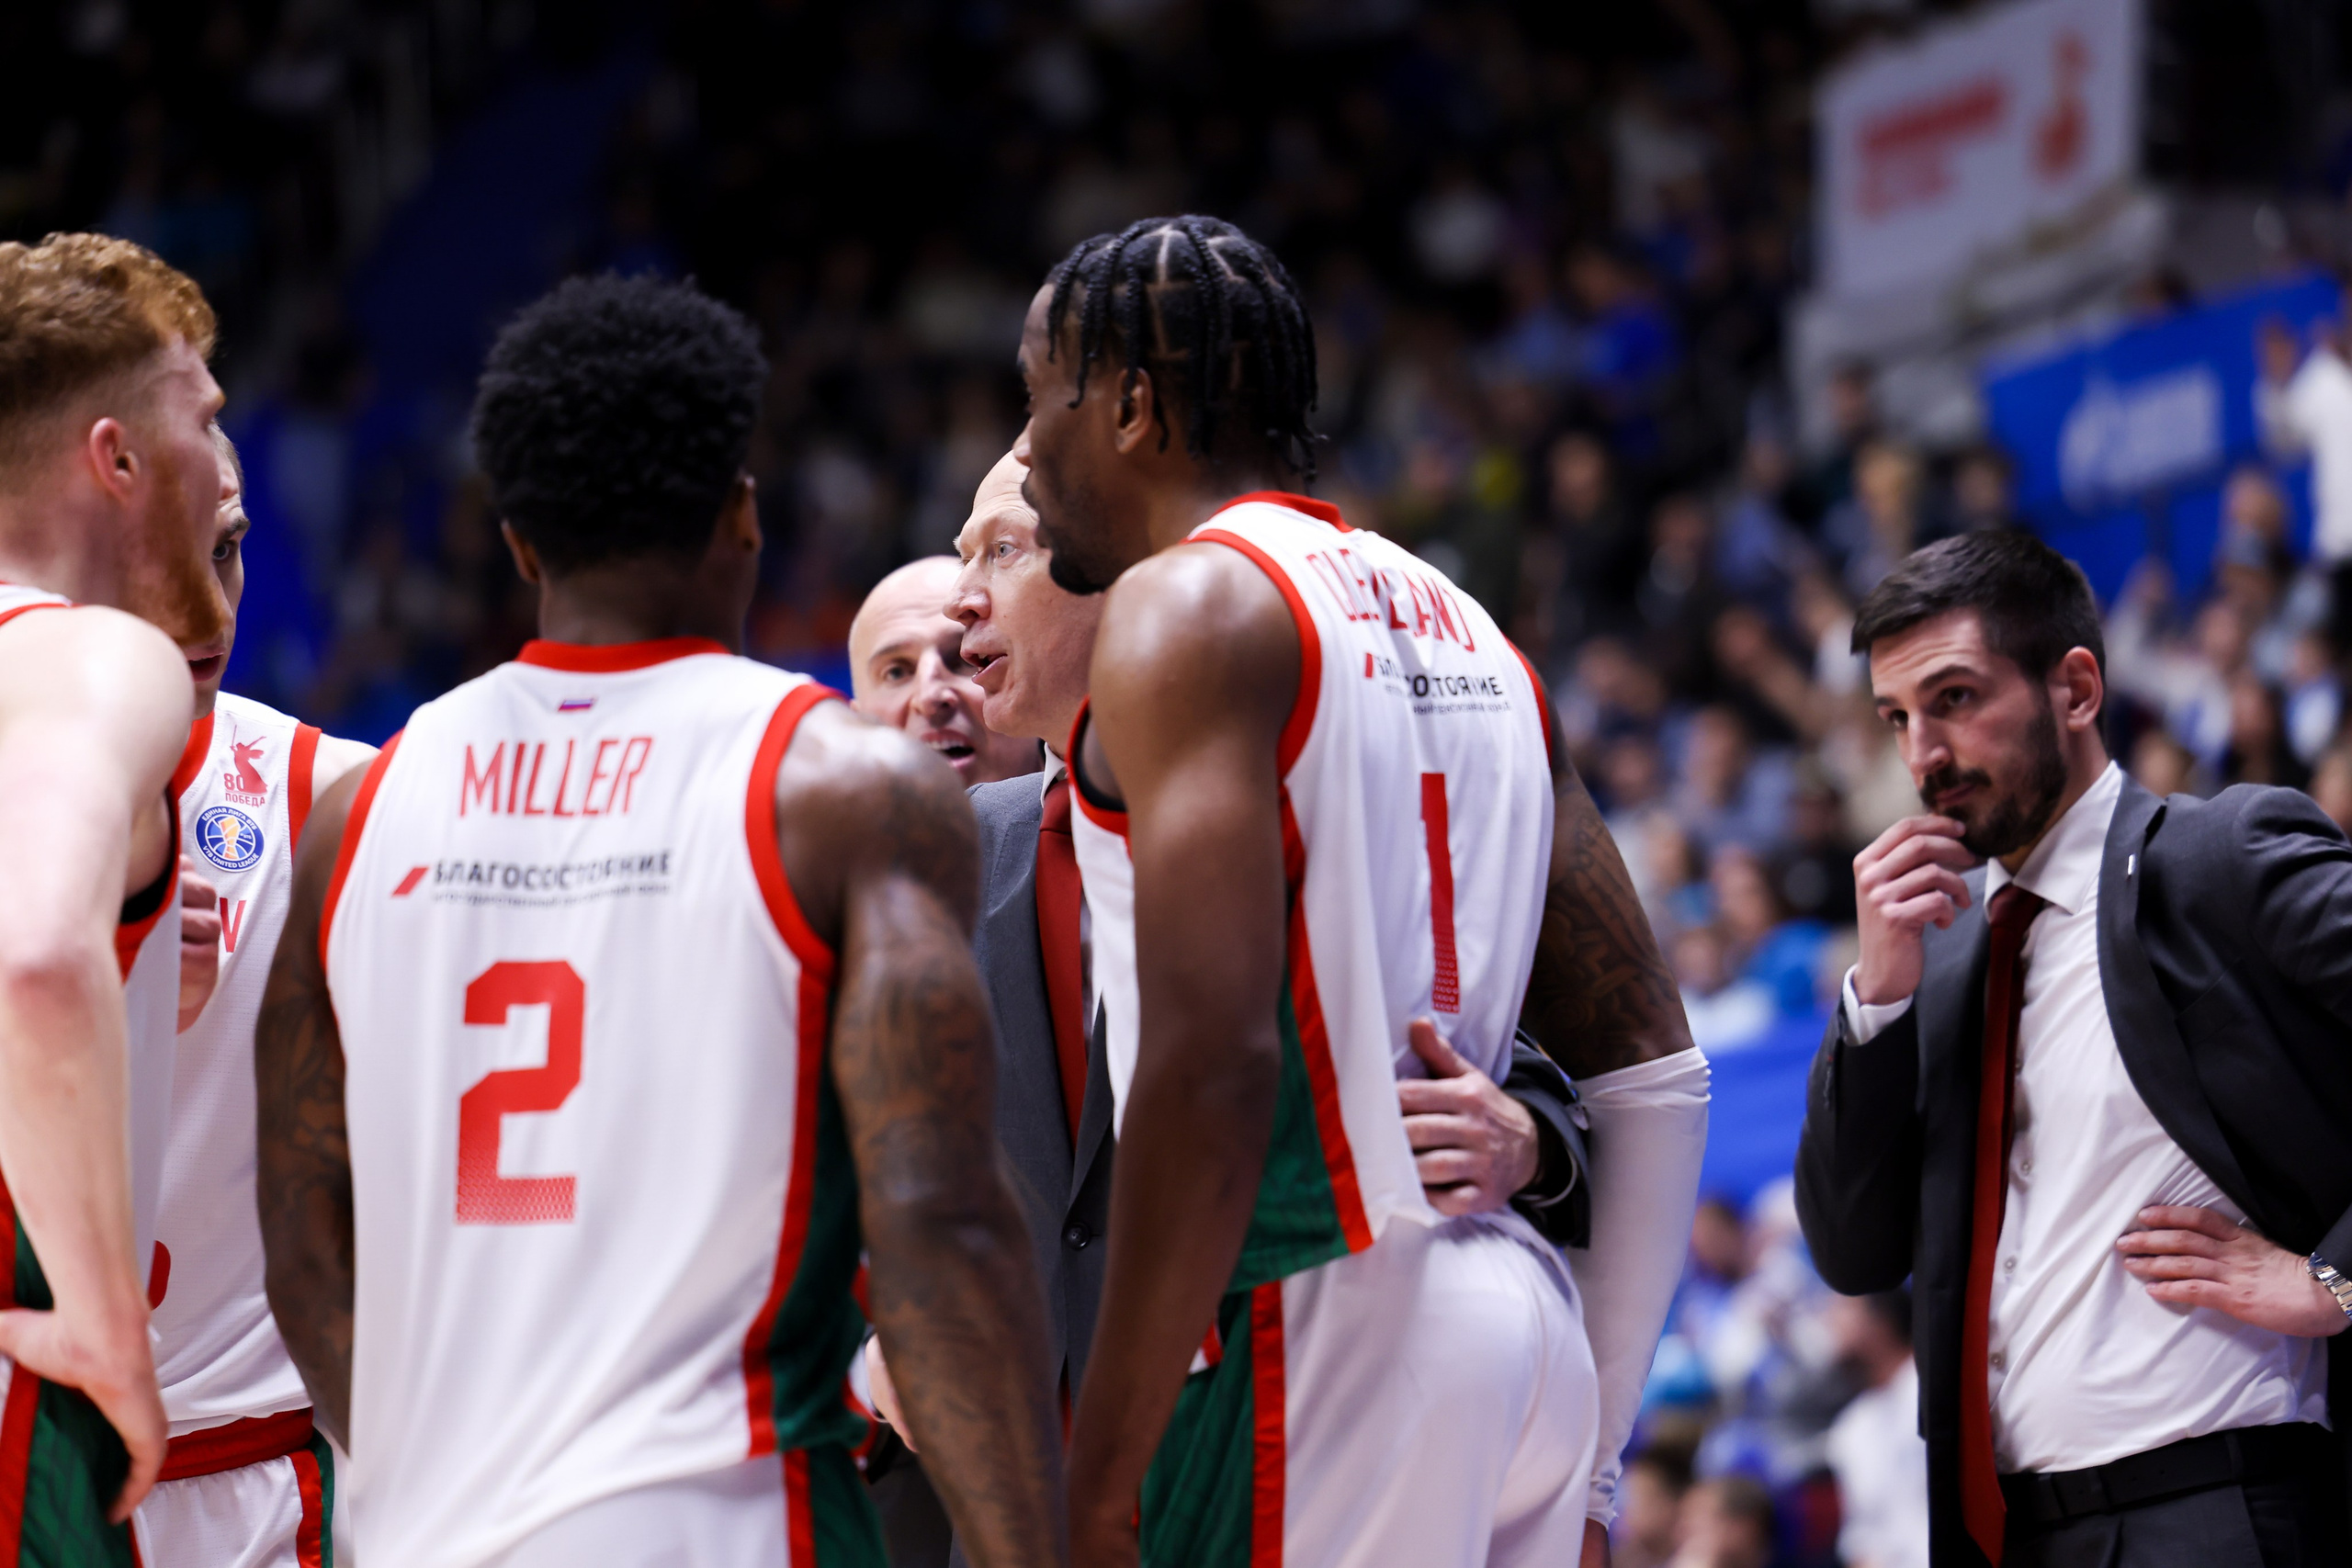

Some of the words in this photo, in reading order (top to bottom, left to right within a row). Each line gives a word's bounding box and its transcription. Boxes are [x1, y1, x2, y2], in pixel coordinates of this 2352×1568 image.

[223, 773, 245, 792] 80
[458, 736, 653, 818] MILLER
[225, 793, 266, 807] ПОБЕДА
[201, 807, 228, 822] ЕДИНАЯ
[228, 808, 246, 821] ЛИГА
[202, 845, 214, 858] VTB
[212, 855, 238, 869] UNITED
[238, 852, 260, 868] LEAGUE
[1420, 773, 1460, 1014] 1
[457, 960, 585, 1225] 2
